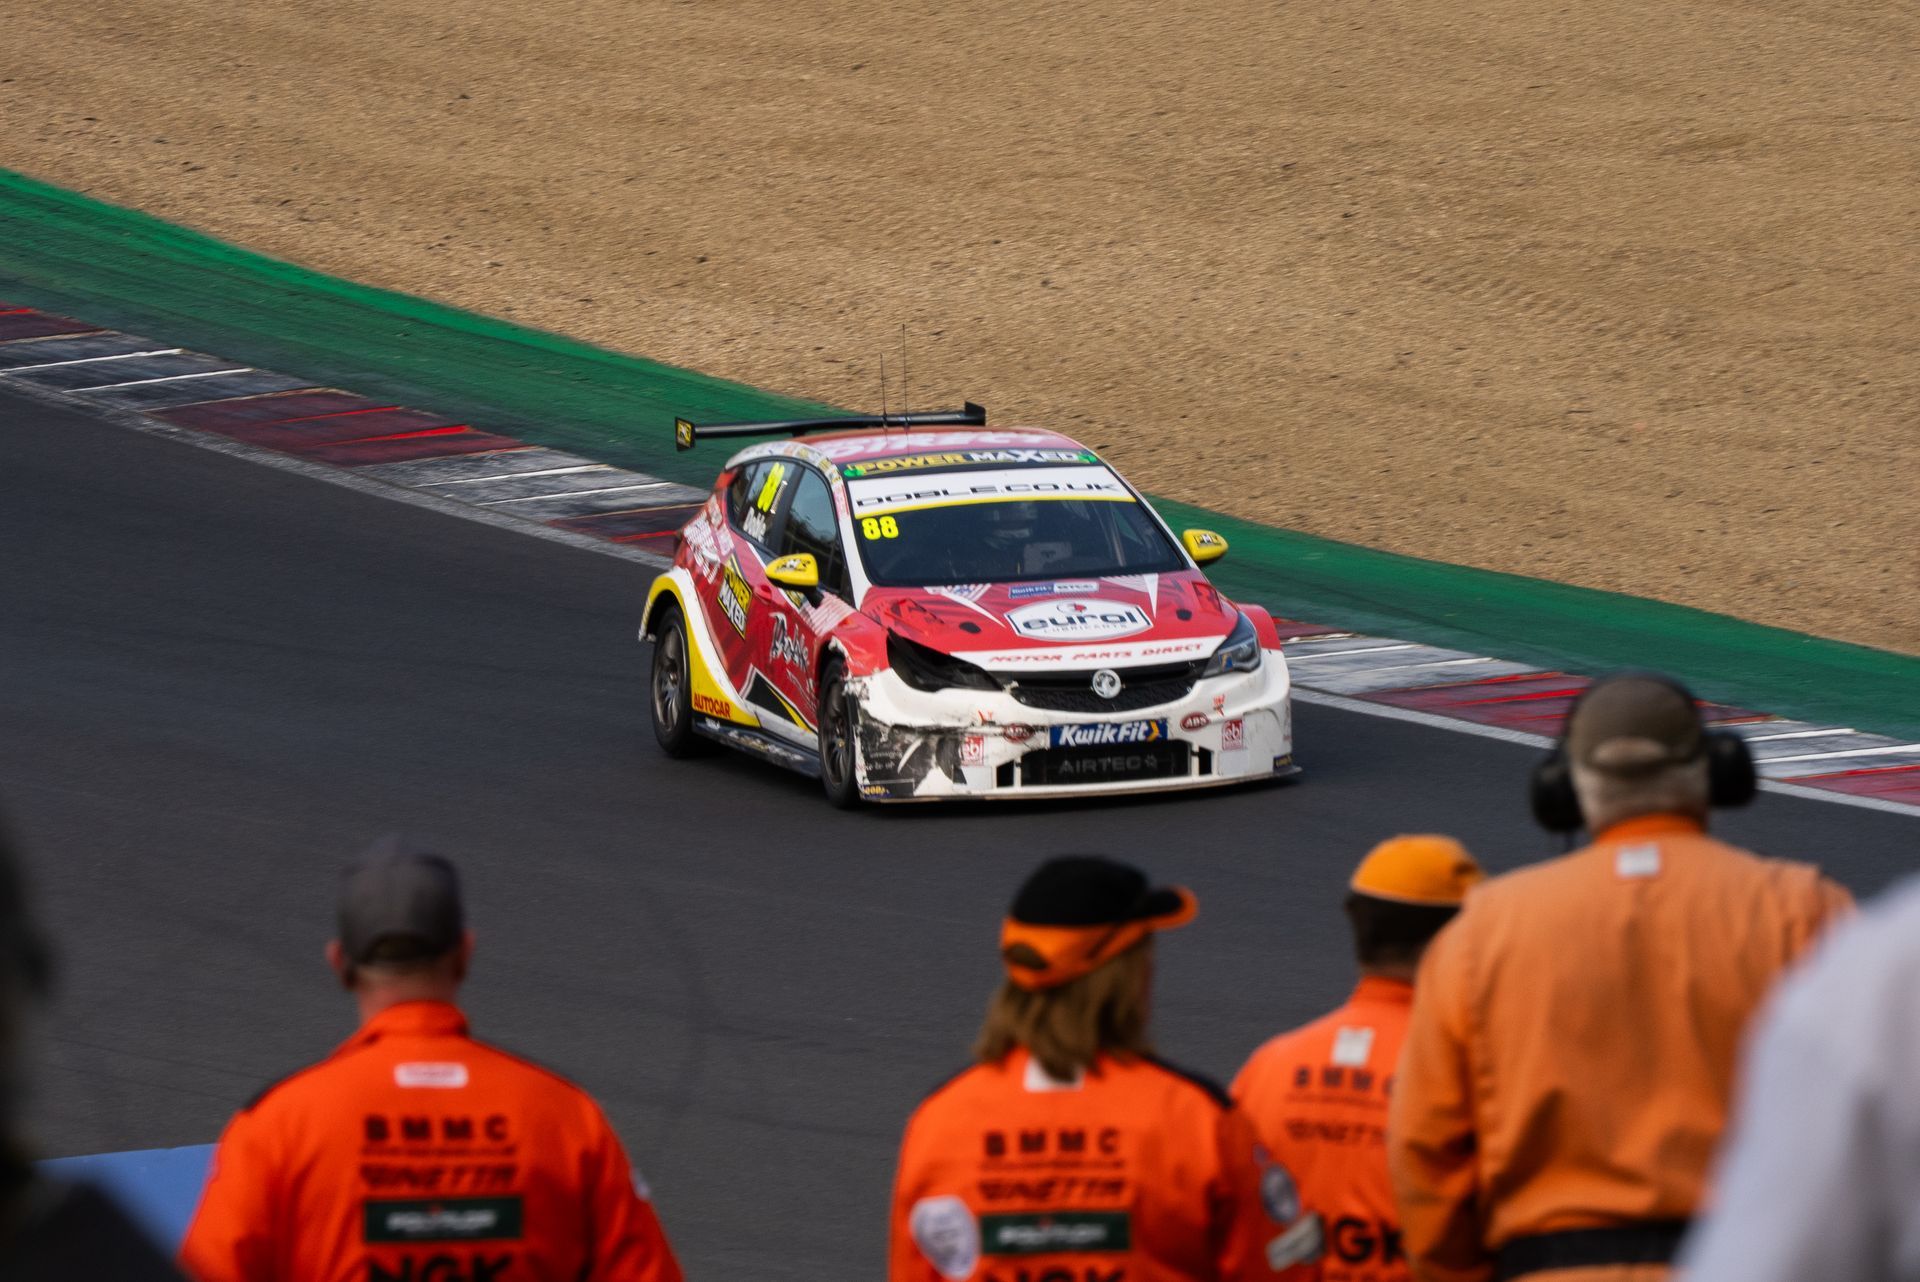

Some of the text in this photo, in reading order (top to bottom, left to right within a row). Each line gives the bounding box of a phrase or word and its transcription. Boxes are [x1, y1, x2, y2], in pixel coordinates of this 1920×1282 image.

[856, 449, 1079, 473] POWER MAXED
[861, 515, 899, 540] 88
[1023, 610, 1138, 630] eurol
[988, 643, 1204, 664] MOTOR PARTS DIRECT
[693, 693, 731, 718] AUTOCAR
[1058, 756, 1142, 775] AIRTEC
